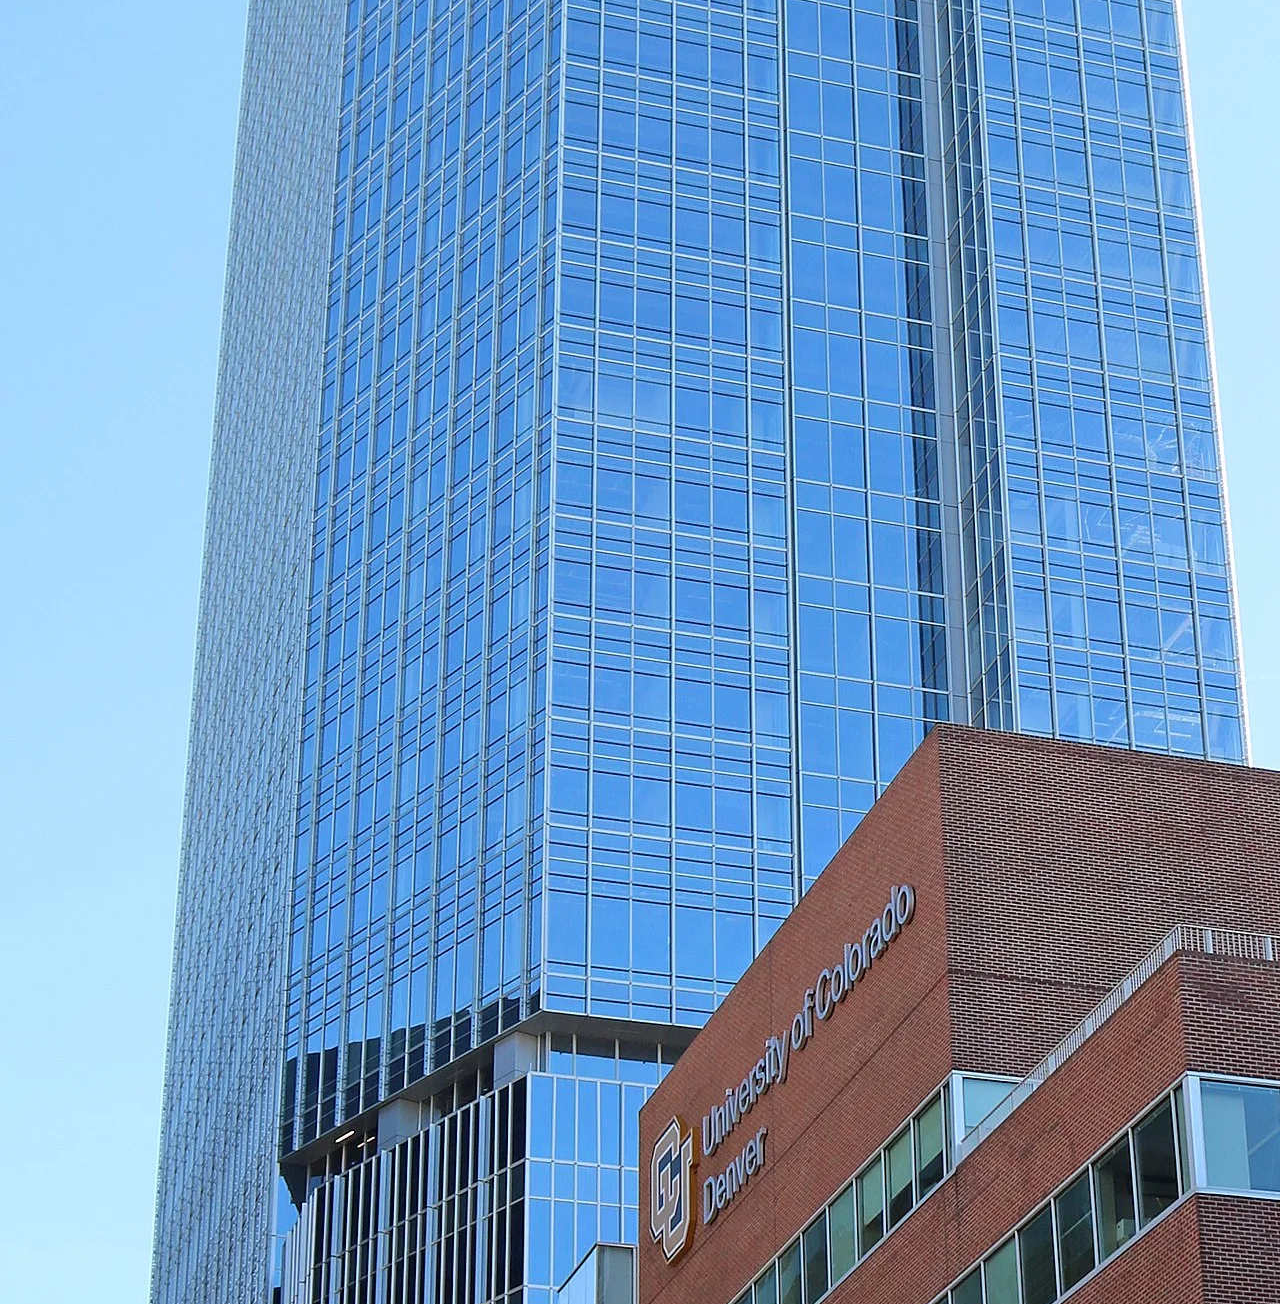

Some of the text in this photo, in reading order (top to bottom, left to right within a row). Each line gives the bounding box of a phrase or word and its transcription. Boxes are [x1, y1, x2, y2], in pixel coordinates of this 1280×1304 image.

[703, 884, 915, 1156] University of Colorado
[703, 1126, 768, 1225] Denver
